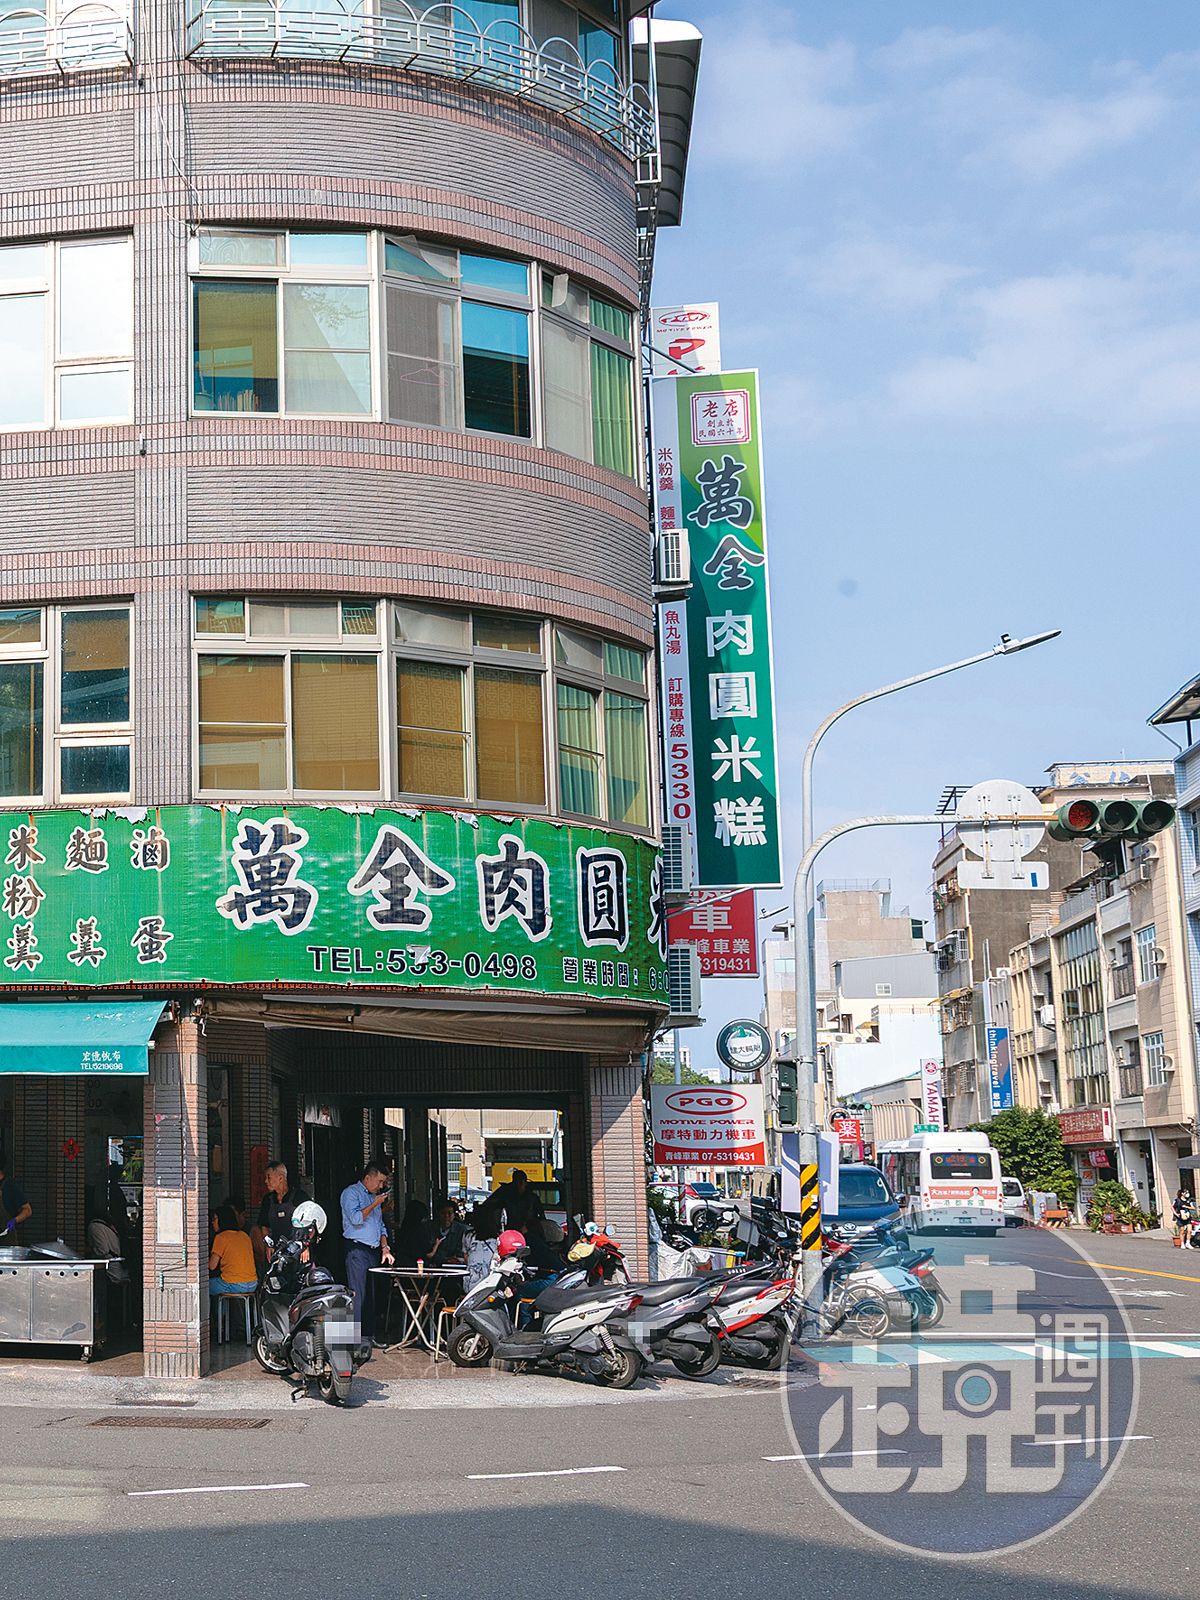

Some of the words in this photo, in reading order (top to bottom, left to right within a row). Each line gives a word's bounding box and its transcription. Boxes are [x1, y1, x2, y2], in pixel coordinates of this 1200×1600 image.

[702, 399, 738, 418] 老店
[698, 427, 743, 438] 民國六十年
[658, 447, 674, 491] 米粉羹
[665, 610, 681, 655] 魚丸湯
[687, 454, 767, 847] 萬全肉圓米糕
[668, 677, 685, 738] 訂購專線
[2, 824, 47, 972] 米粉羹
[65, 828, 109, 969] 麵羹
[129, 826, 173, 966] 滷蛋
[701, 957, 751, 971] 319431
[678, 1097, 734, 1107] PGO
[926, 1081, 940, 1123] YAMAH
[661, 1129, 756, 1140] 摩特動力機車
[701, 1152, 755, 1161] 07-5319431
